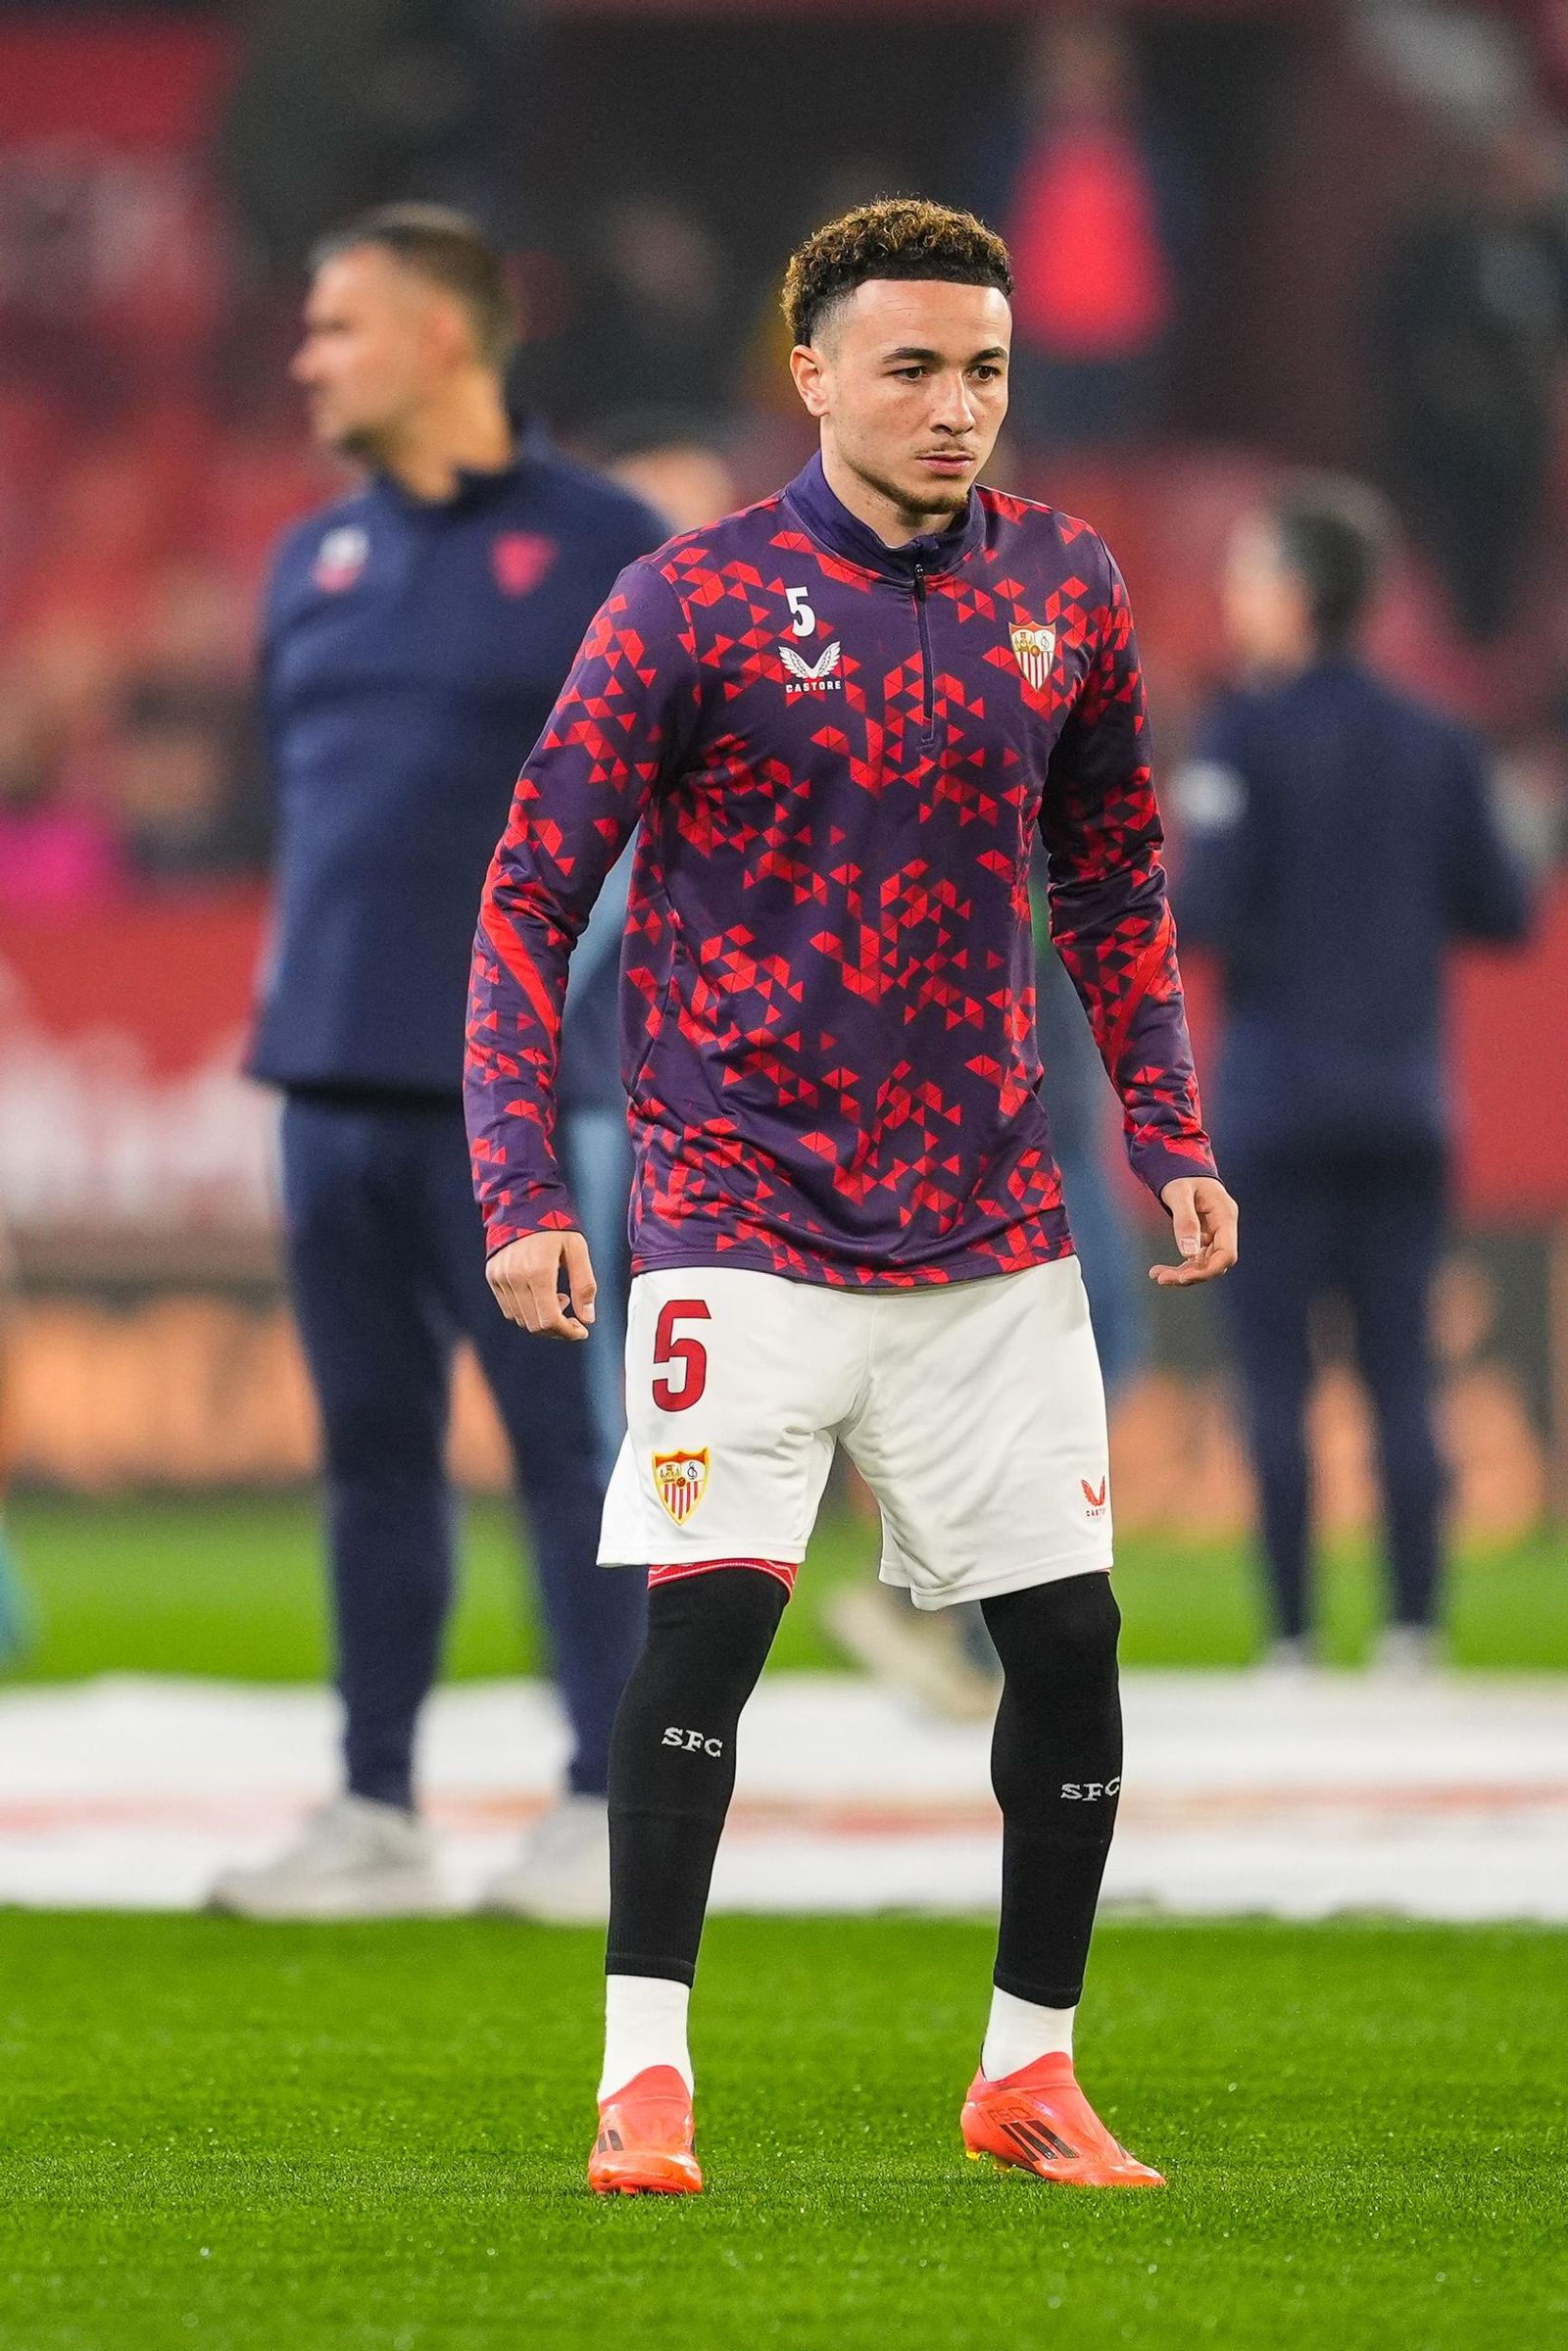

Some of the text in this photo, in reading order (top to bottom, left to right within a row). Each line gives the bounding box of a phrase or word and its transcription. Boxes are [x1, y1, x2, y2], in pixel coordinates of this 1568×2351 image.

[785, 586, 815, 637] 5
[785, 680, 842, 694] CASTORE
[652, 1299, 711, 1412] 5
[662, 1726, 723, 1758] SFC
[1060, 1776, 1120, 1802] SFC
